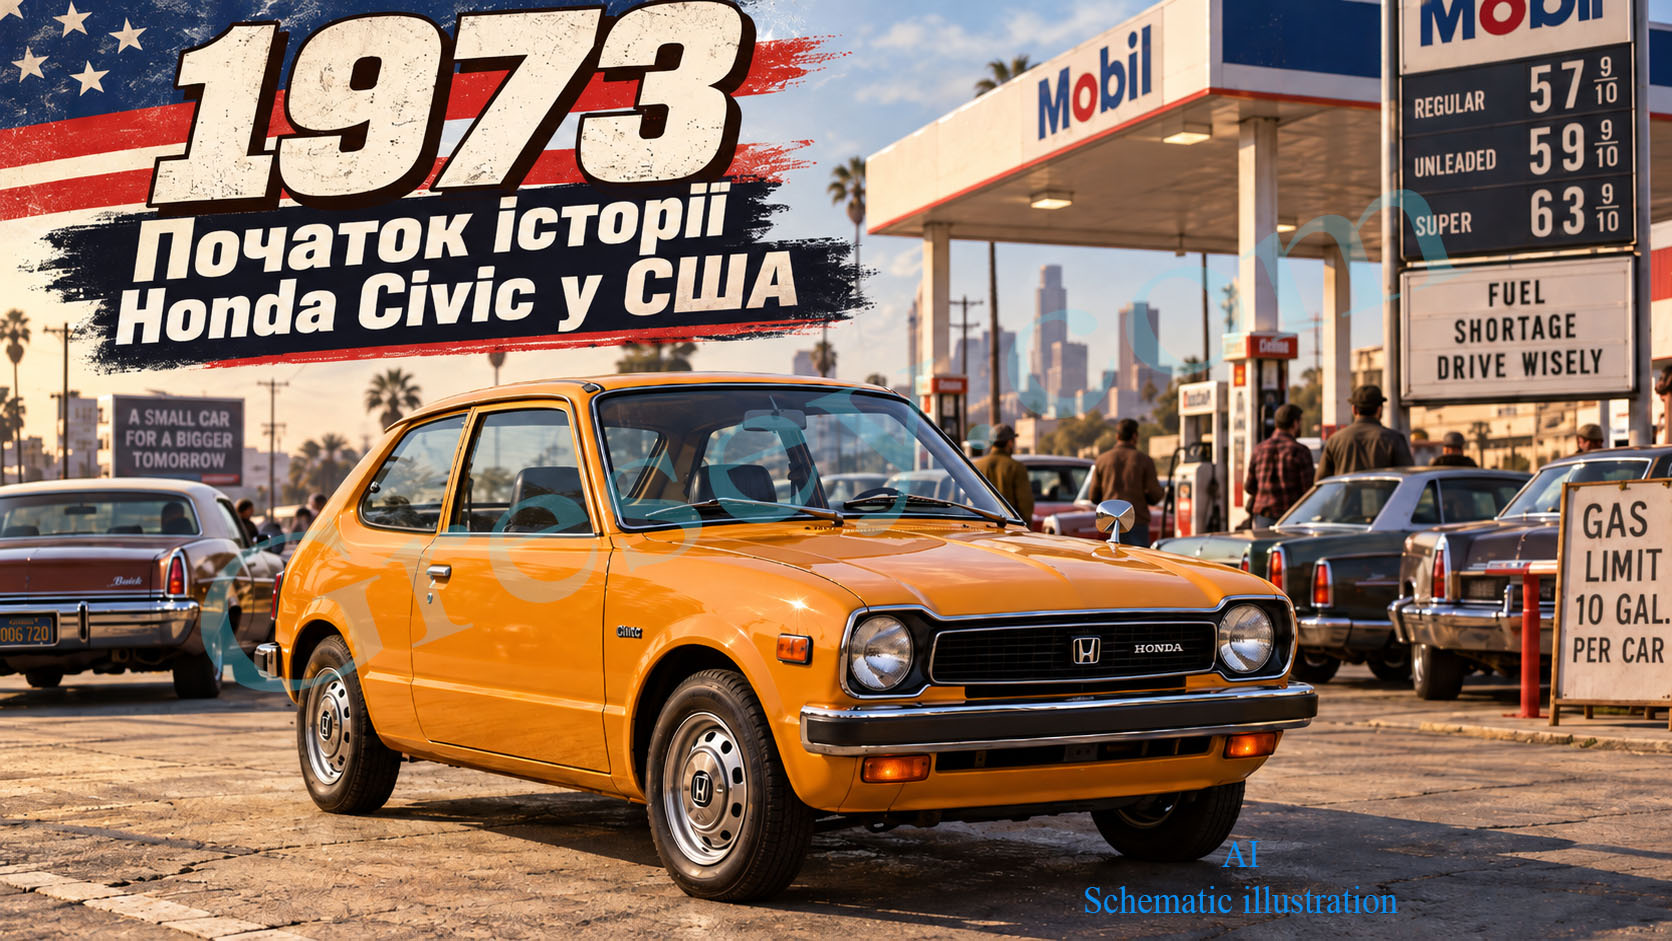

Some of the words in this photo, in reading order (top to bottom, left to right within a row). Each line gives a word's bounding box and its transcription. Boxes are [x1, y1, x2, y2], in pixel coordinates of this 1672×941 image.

[1420, 0, 1603, 47] Mob
[1038, 24, 1152, 140] Mobil
[1414, 90, 1485, 119] REGULAR
[1414, 148, 1497, 178] UNLEADED
[1415, 211, 1472, 237] SUPER
[1488, 279, 1546, 308] FUEL
[1454, 313, 1577, 344] SHORTAGE
[1437, 352, 1507, 381] DRIVE
[1521, 348, 1603, 377] WISELY
[128, 408, 141, 425] A
[144, 408, 196, 427] SMALL
[199, 410, 230, 428] CAR
[125, 429, 157, 447] FOR
[160, 430, 173, 447] A
[176, 430, 233, 449] BIGGER
[132, 451, 226, 469] TOMORROW
[1583, 500, 1648, 540] GAS
[1585, 548, 1663, 583] LIMIT
[108, 576, 143, 587] Buick
[1575, 593, 1604, 626] 10
[1616, 593, 1671, 626] GAL.
[26, 625, 49, 642] 720
[1134, 643, 1184, 654] HONDA
[1573, 636, 1611, 663] PER
[1622, 636, 1665, 664] CAR
